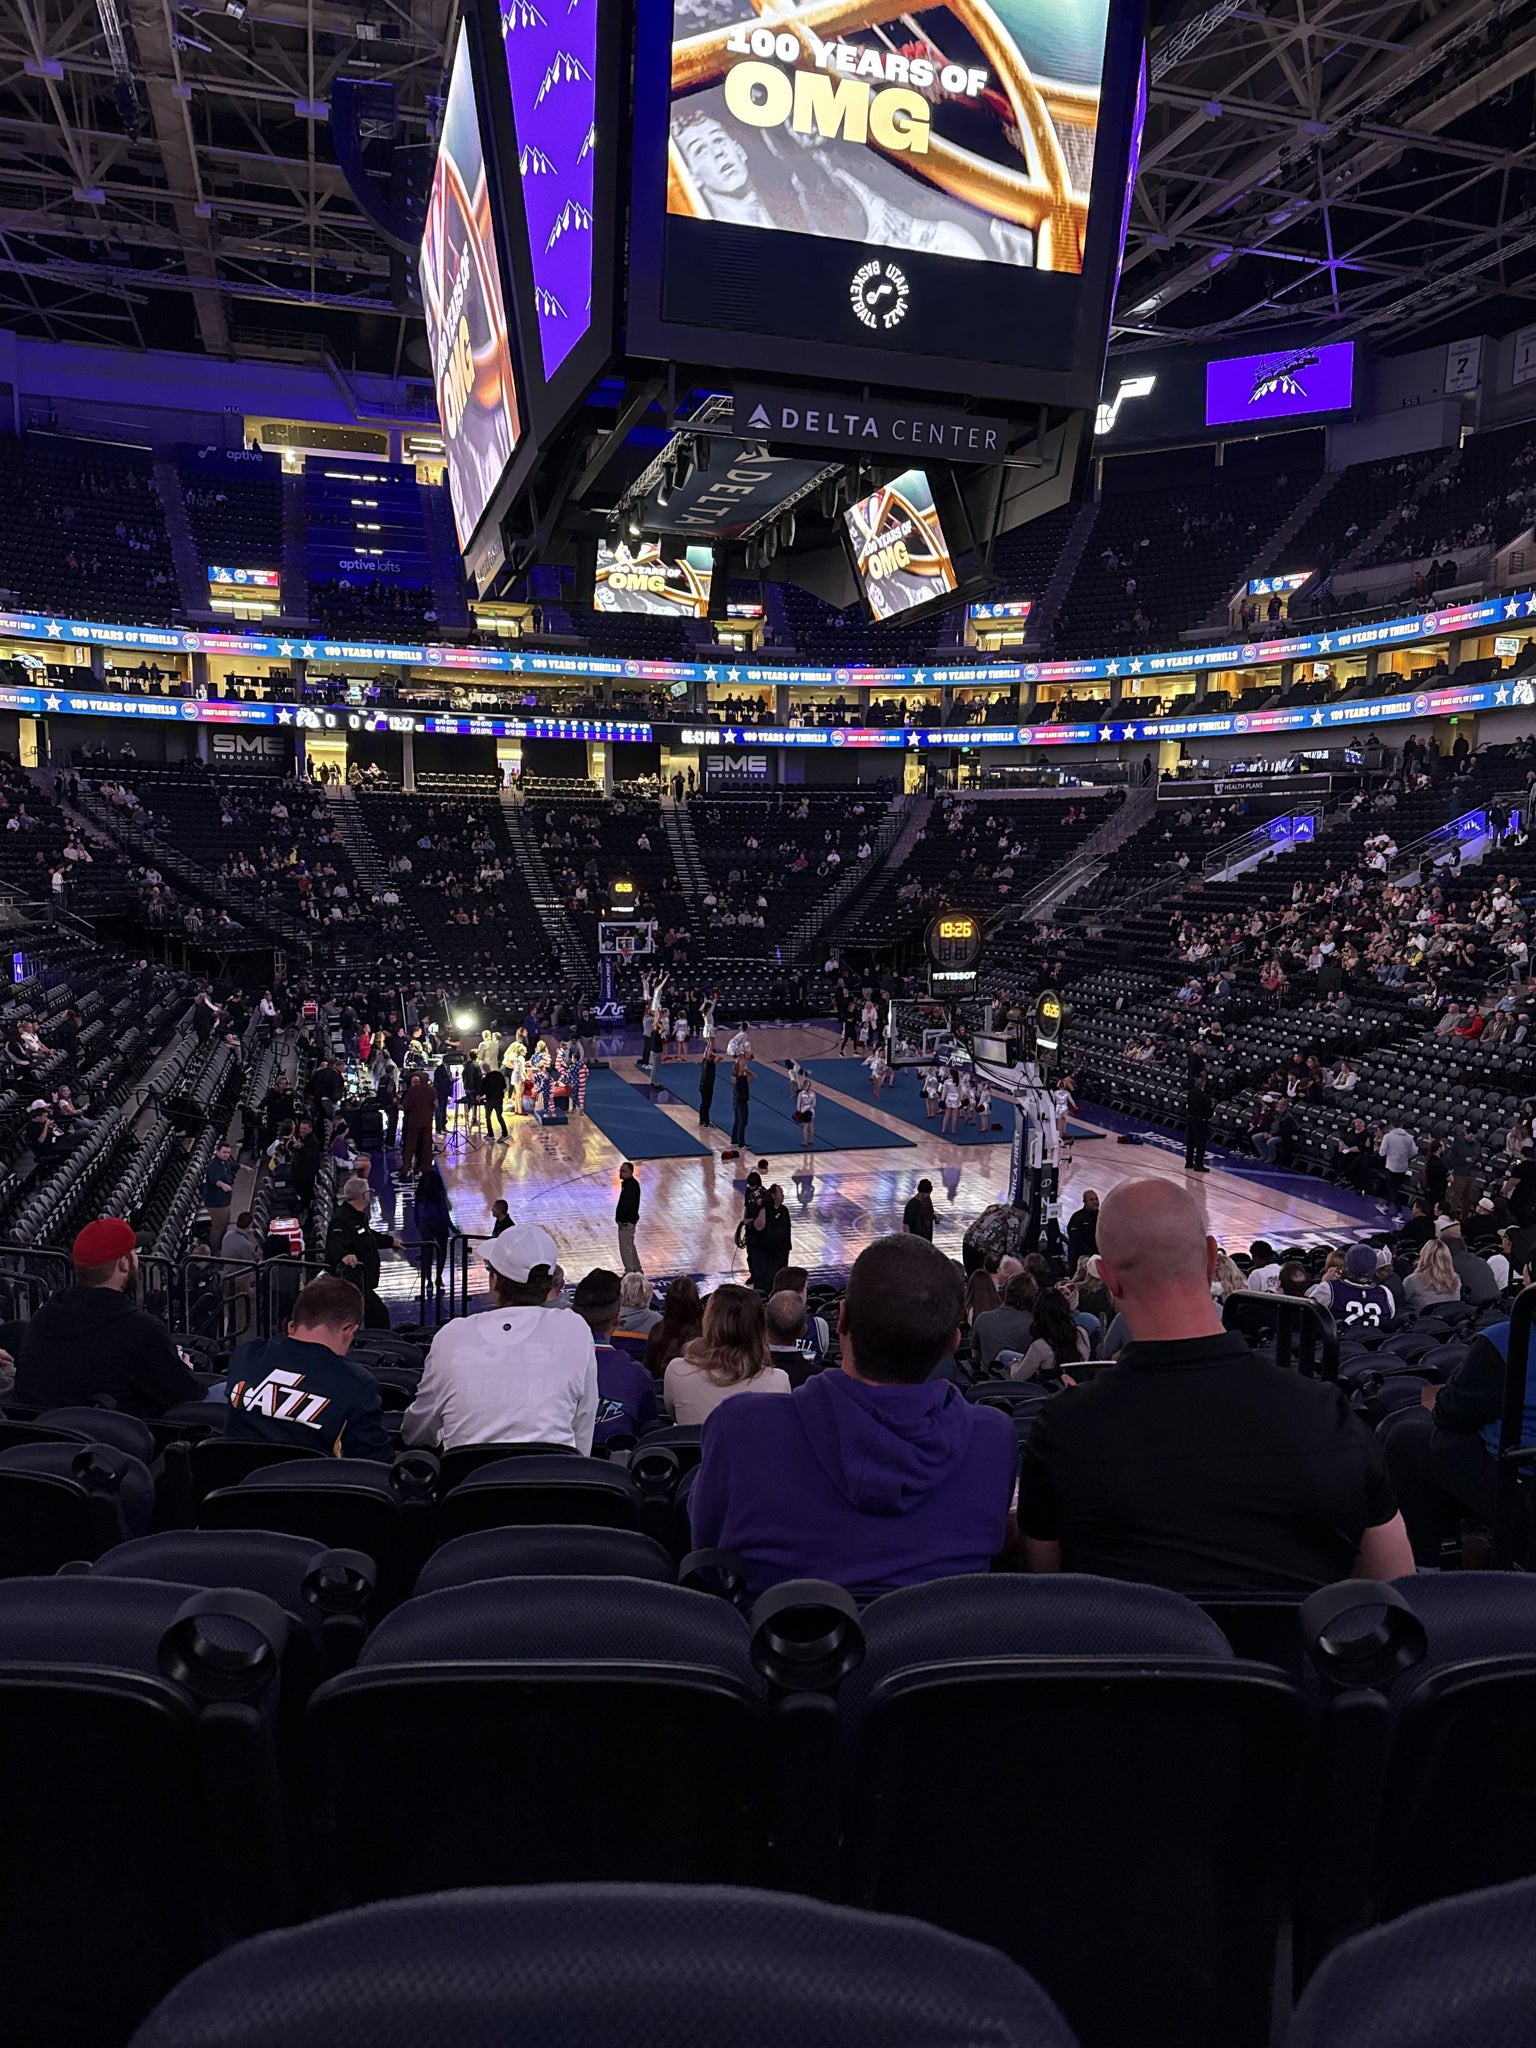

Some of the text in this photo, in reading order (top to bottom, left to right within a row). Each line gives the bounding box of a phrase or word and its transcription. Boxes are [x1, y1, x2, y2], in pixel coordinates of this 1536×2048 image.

[726, 26, 989, 96] 100 YEARS OF
[724, 60, 931, 154] OMG
[850, 260, 880, 329] BASKETBALL
[883, 263, 910, 329] UTAH JAZZ
[1457, 357, 1469, 374] 7
[444, 315, 475, 440] OMG
[781, 408, 998, 450] DELTA CENTER
[226, 450, 263, 462] aptive
[674, 469, 773, 524] DELTA
[877, 526, 902, 548] YEARS
[900, 520, 912, 535] OF
[339, 559, 400, 573] aptive lofts
[868, 540, 911, 580] OMG
[631, 566, 666, 576] YEARS
[666, 568, 682, 578] OF
[608, 572, 665, 592] OMG
[71, 626, 178, 645] 100 YEARS OF THRILLS
[1338, 621, 1419, 646] 100 YEARS OF THRILLS
[324, 646, 422, 661] 100 YEARS OF THRILLS
[1150, 650, 1238, 669] 100 YEARS OF THRILLS
[533, 658, 621, 673] 100 YEARS OF THRILLS
[747, 670, 831, 681] 100 YEARS OF THRILLS
[933, 668, 1020, 681] 100 YEARS OF THRILLS
[70, 698, 177, 715] 100 YEARS OF THRILLS
[1330, 701, 1411, 720] 100 YEARS OF THRILLS
[325, 714, 335, 727] 0
[349, 715, 359, 728] 0
[1143, 720, 1230, 736] 100 YEARS OF THRILLS
[213, 734, 285, 755] SME
[705, 731, 719, 745] PM
[743, 732, 827, 742] 100 YEARS OF THRILLS
[927, 732, 1014, 743] 100 YEARS OF THRILLS
[707, 755, 766, 772] SME
[1224, 783, 1245, 791] HEALTH
[940, 922, 972, 938] 19:26
[945, 972, 976, 980] TISSOT
[1012, 1130, 1021, 1165] FIRST
[1344, 1301, 1382, 1327] 23
[236, 1368, 331, 1430] JAZZ
